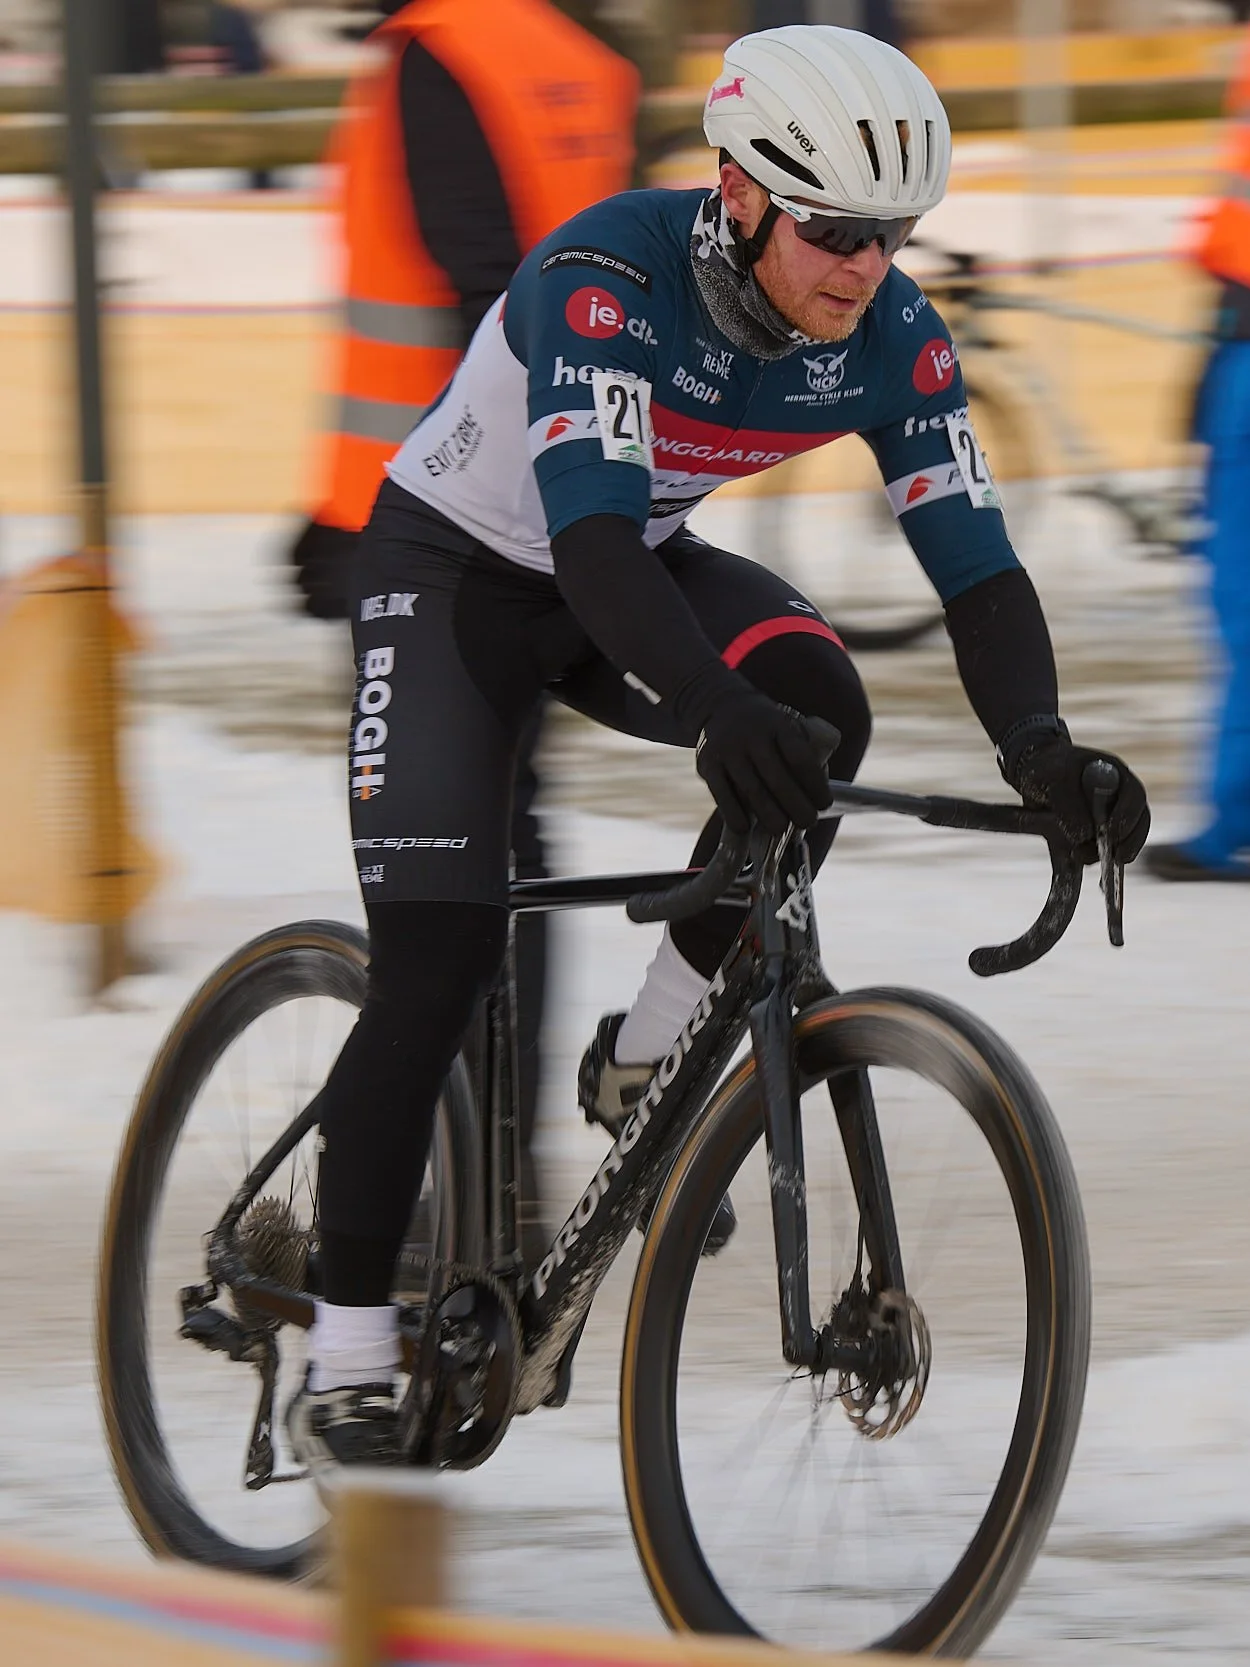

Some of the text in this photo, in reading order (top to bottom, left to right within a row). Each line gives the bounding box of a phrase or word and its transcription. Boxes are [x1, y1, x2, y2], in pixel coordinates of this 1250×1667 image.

[787, 121, 817, 157] uvex
[542, 250, 647, 284] ceramicspeed
[702, 352, 730, 380] REME
[812, 375, 838, 389] HCK
[672, 366, 720, 404] BOGH
[784, 386, 864, 402] HERNING CYKLE KLUB
[607, 385, 643, 444] 21
[651, 437, 785, 464] NGGAARD
[352, 646, 395, 789] BOGH
[532, 966, 727, 1300] PRONGHORN
